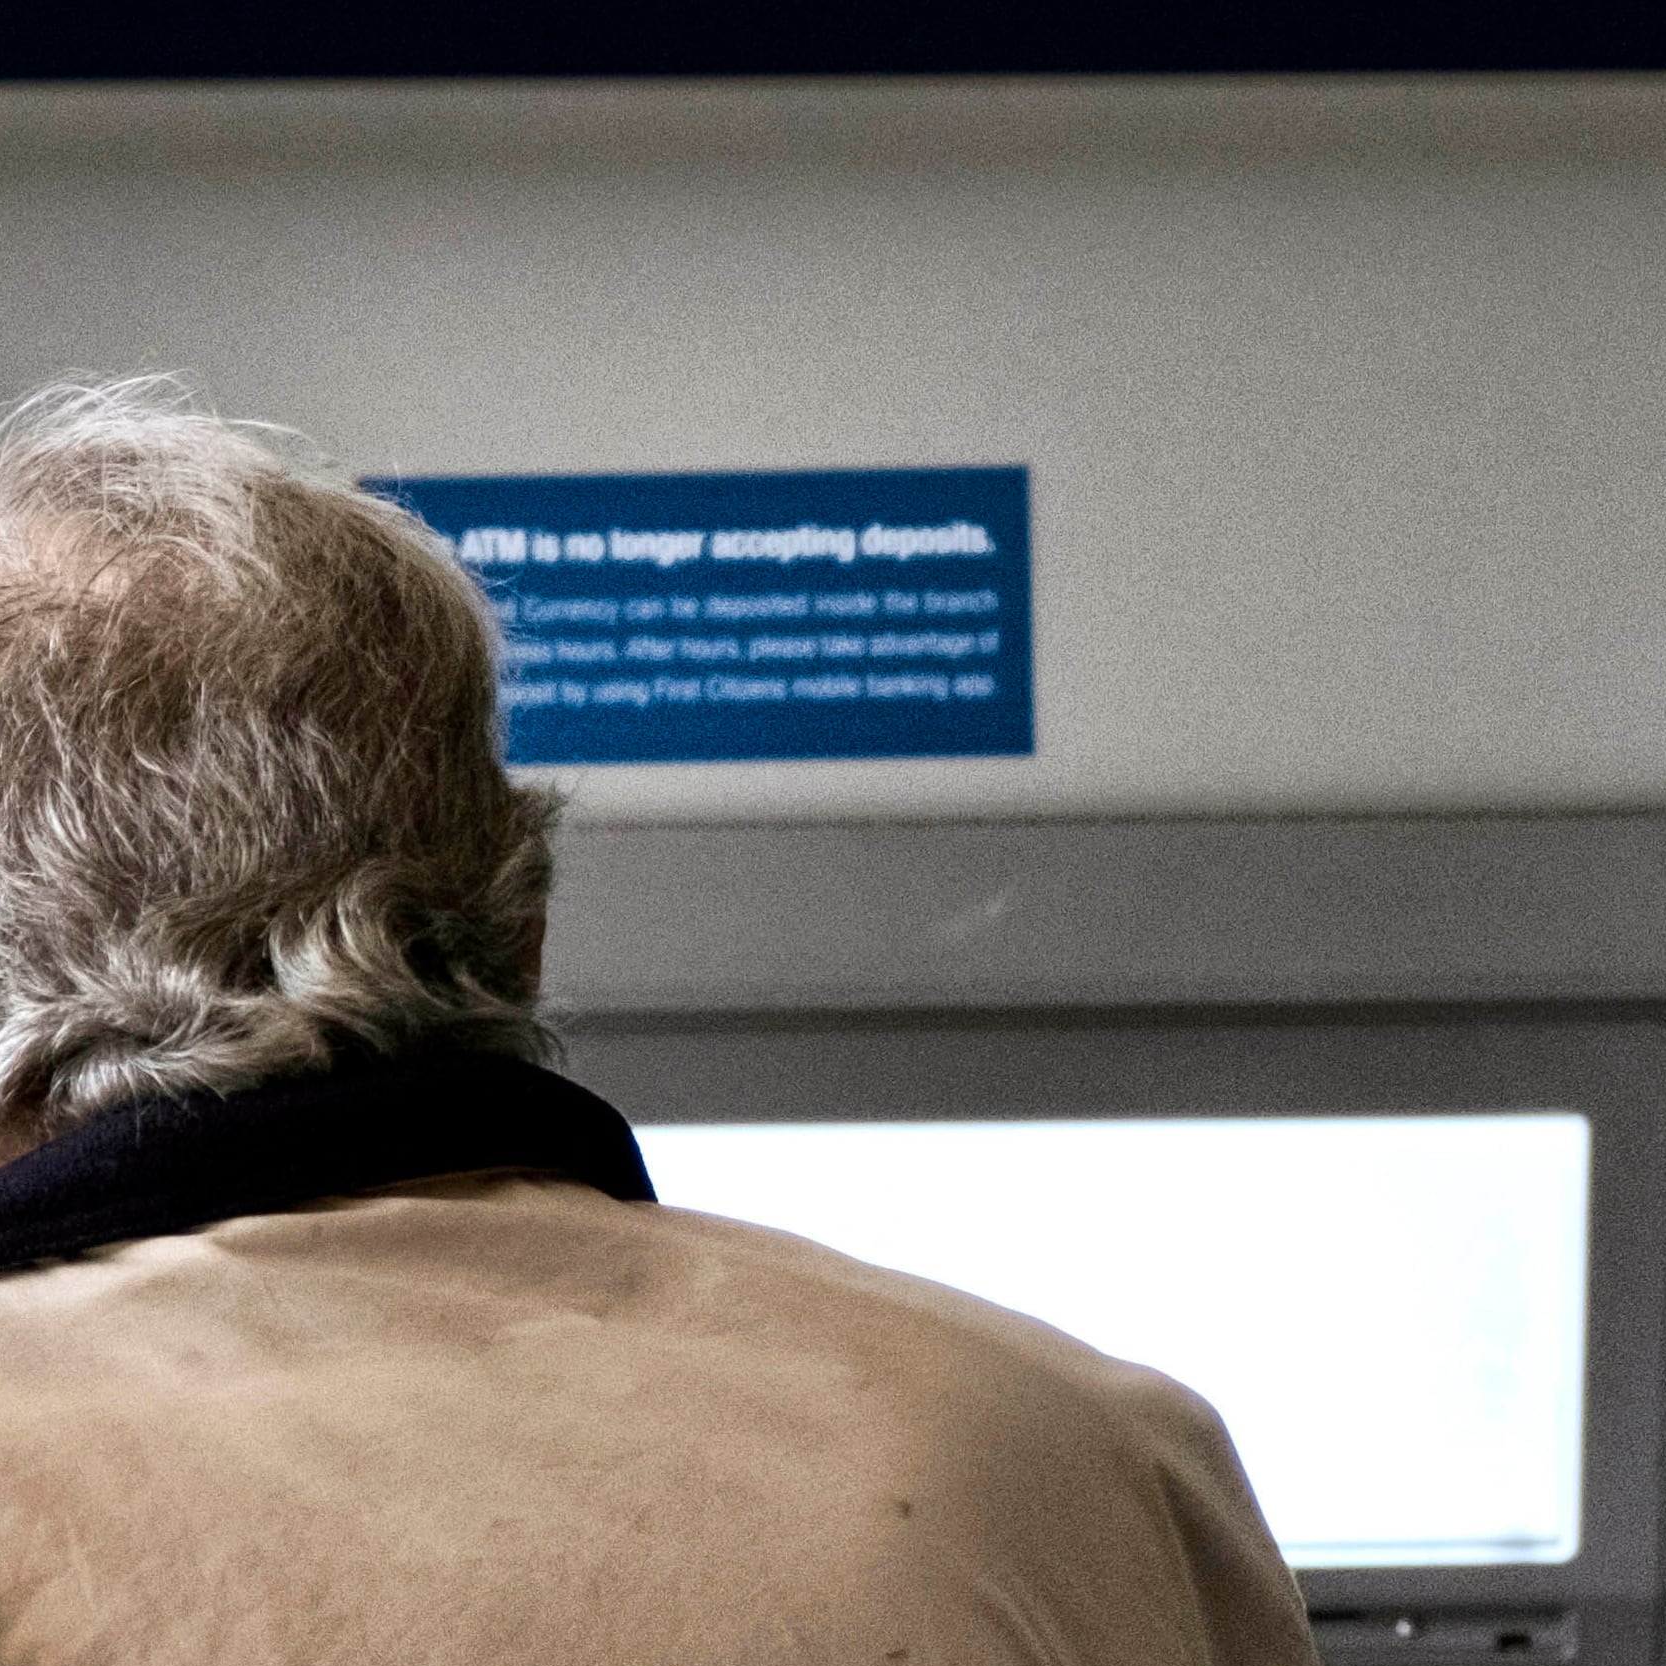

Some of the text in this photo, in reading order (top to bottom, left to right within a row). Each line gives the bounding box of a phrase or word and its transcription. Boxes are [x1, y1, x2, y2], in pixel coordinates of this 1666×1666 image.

[460, 520, 997, 568] ATM is no longer accepting deposits.
[883, 591, 918, 614] the
